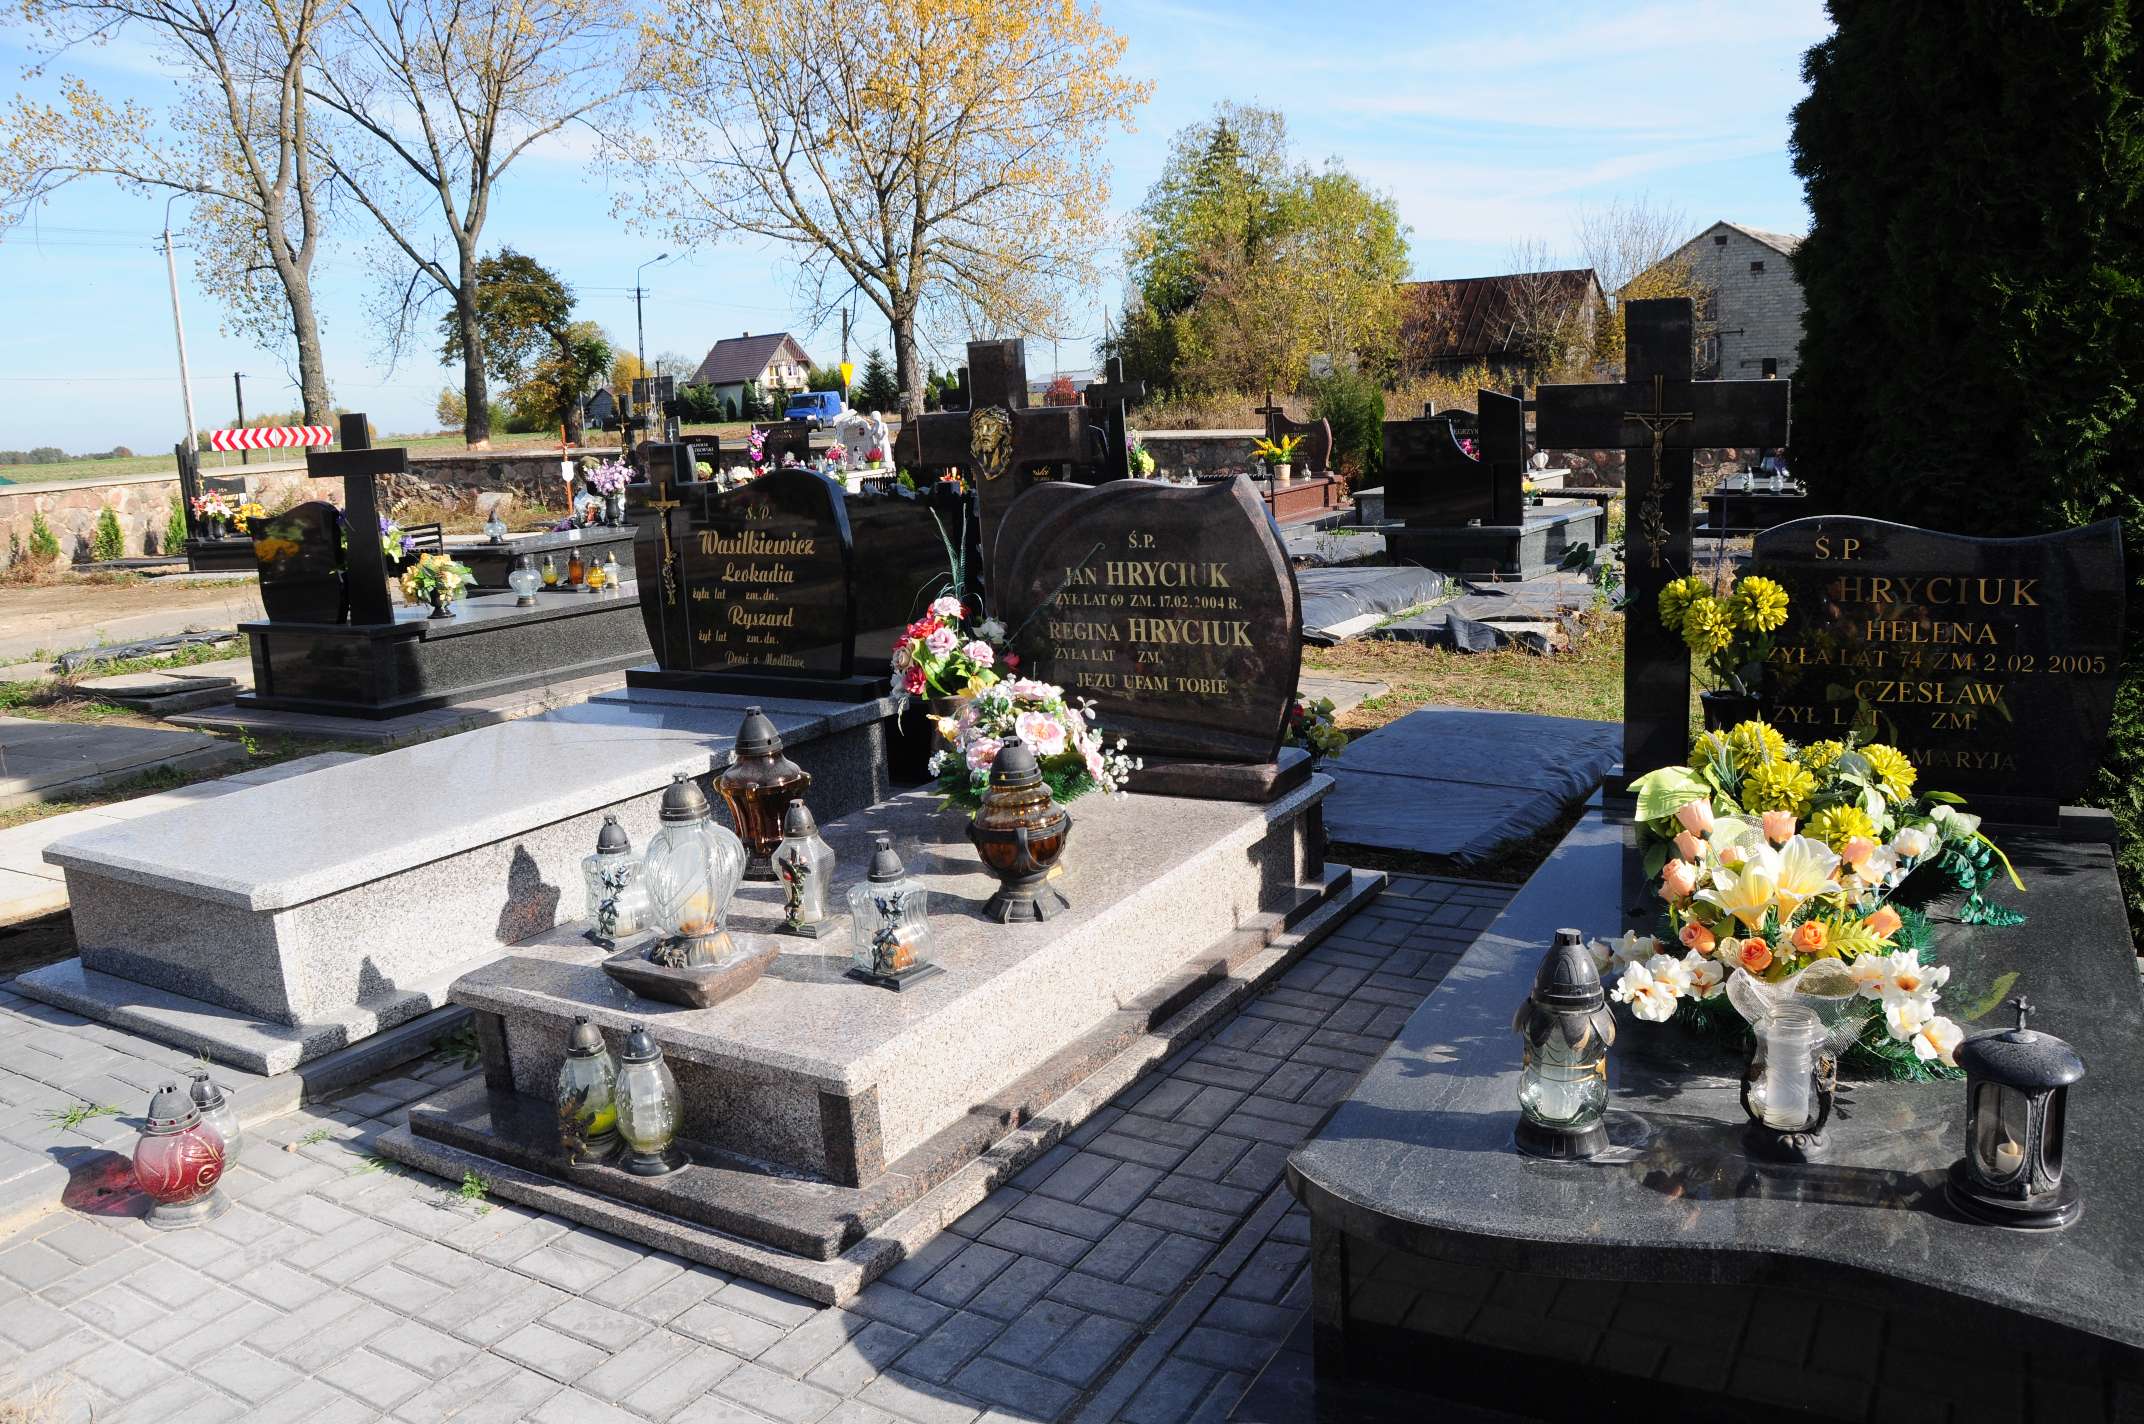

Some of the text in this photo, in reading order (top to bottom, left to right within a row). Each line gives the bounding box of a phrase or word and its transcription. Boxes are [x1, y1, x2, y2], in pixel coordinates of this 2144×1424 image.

[698, 530, 816, 556] Wasilkiewicz
[721, 561, 796, 583] Leokadia
[1063, 561, 1231, 588] JAN HRYCIUK
[714, 587, 726, 600] lat
[1083, 593, 1108, 606] LAT
[1111, 594, 1124, 607] 69
[1130, 594, 1156, 607] ZM.
[1228, 597, 1243, 610] R.
[1838, 575, 2041, 607] HRYCIUK
[727, 604, 795, 630] Ryszard
[715, 629, 728, 642] lat
[1049, 618, 1254, 647] REGINA HRYCIUK
[1865, 620, 2000, 645] HELENA
[753, 656, 759, 665] o
[1091, 649, 1116, 662] LAT
[1137, 650, 1164, 664] ZM.
[1840, 648, 1889, 668] LAT
[1900, 651, 1922, 669] 74
[1076, 672, 1229, 694] JEZU UFAM TOBIE
[1854, 680, 2004, 706] CZESŁAW
[1832, 706, 1883, 727] LAT
[1912, 748, 2017, 771] MARYJA
